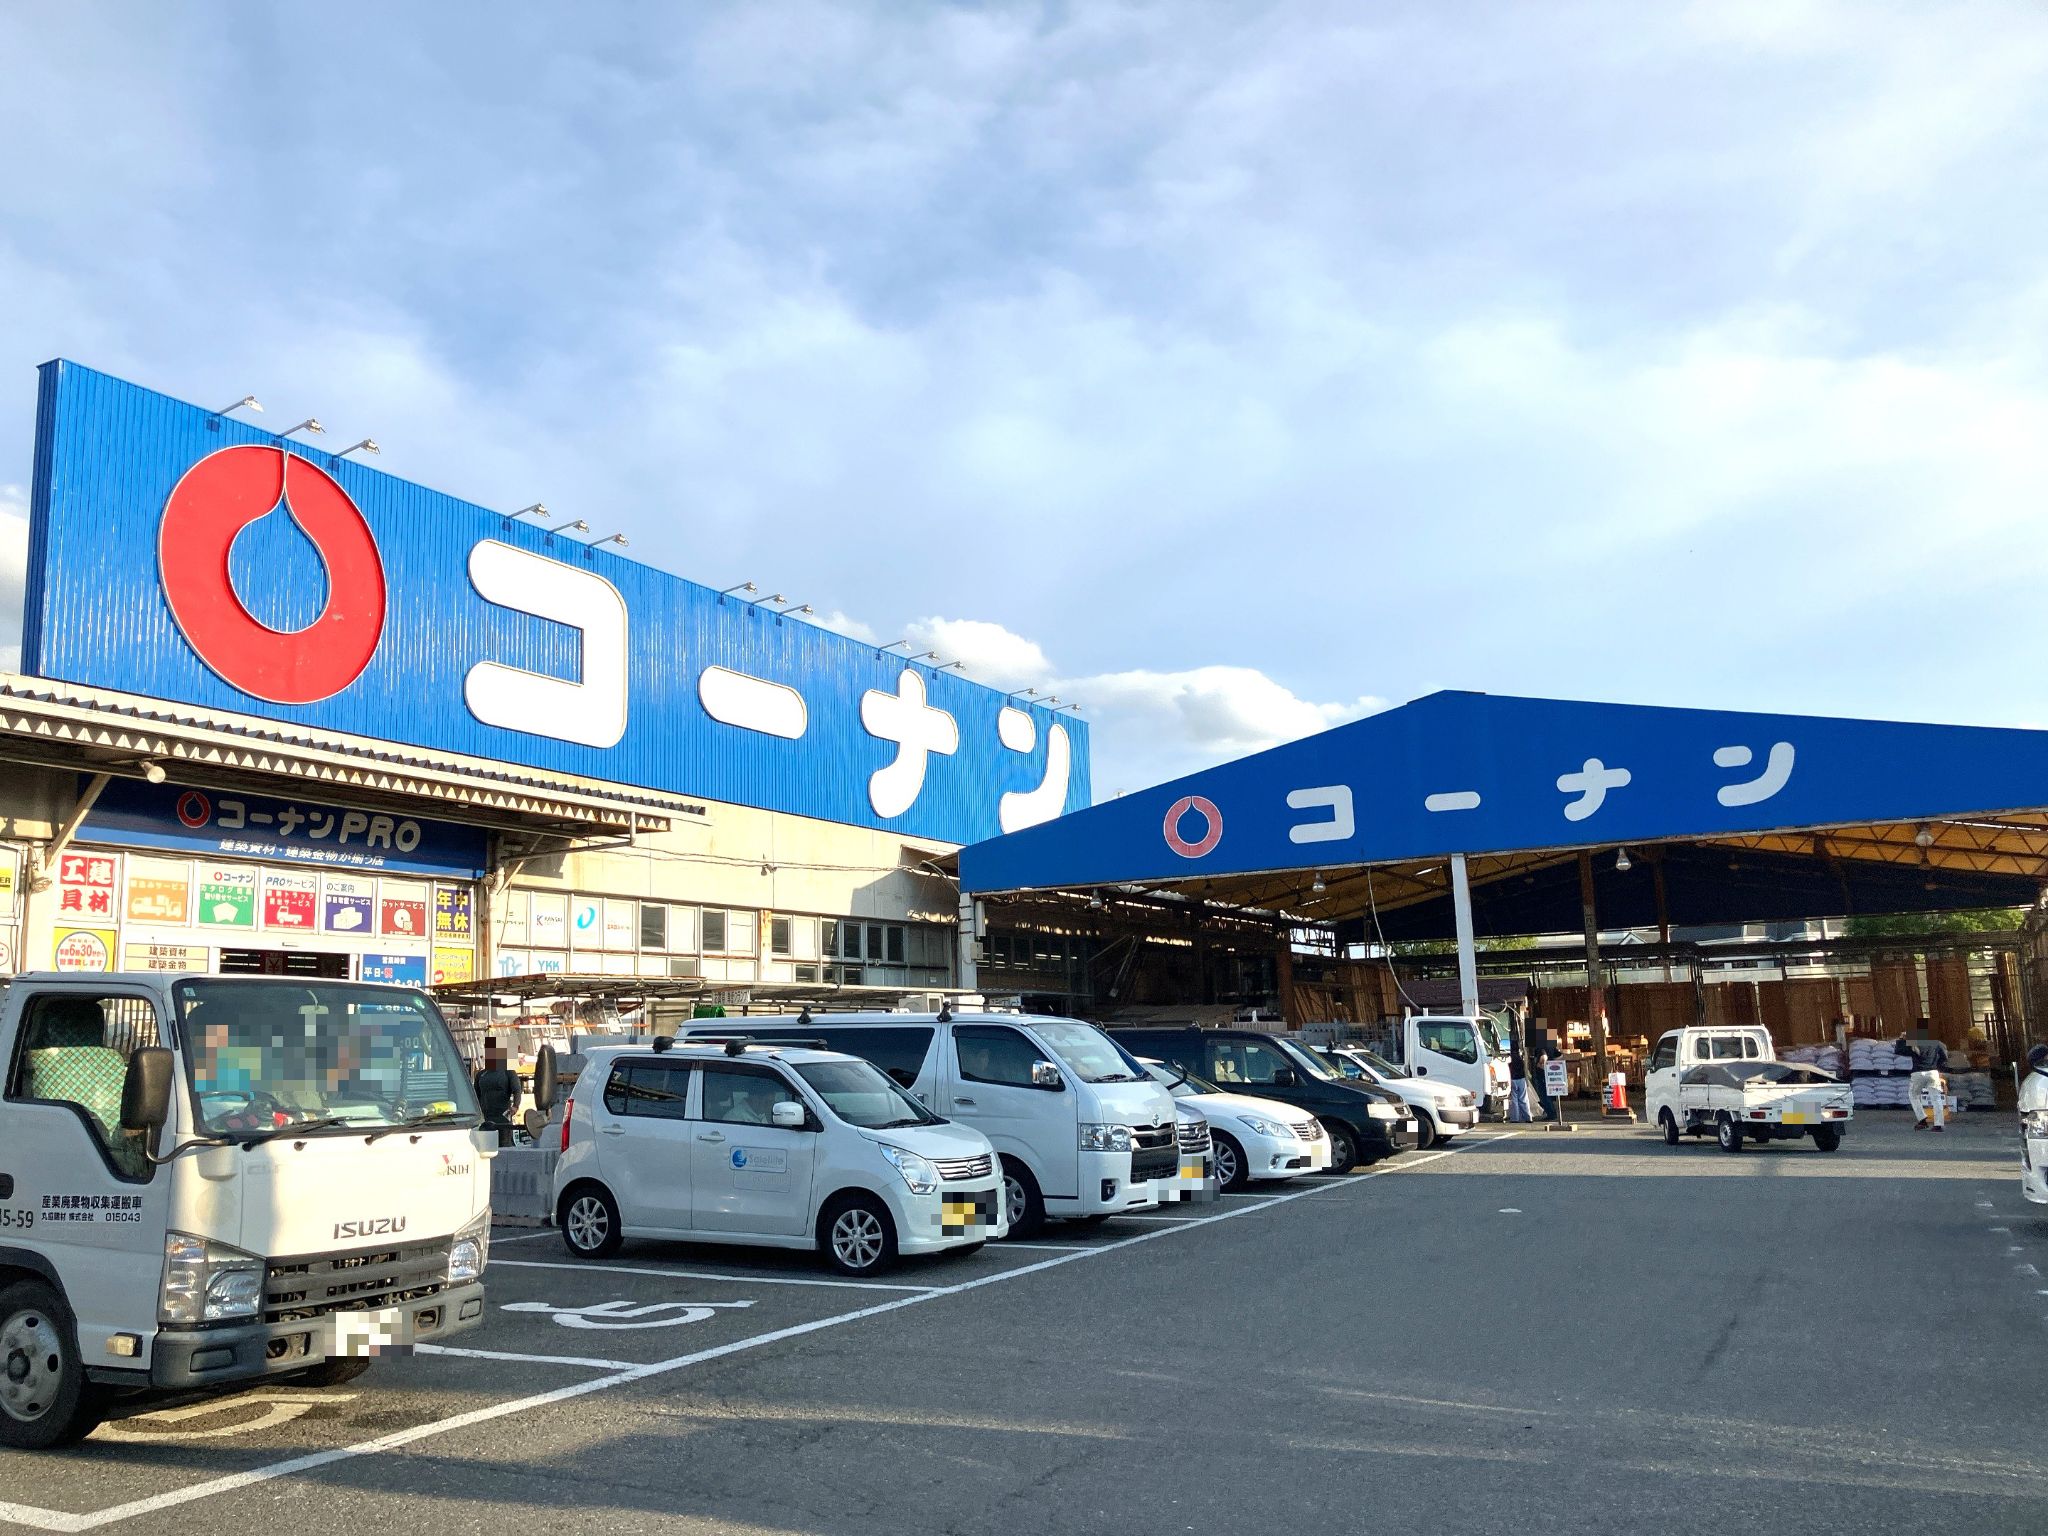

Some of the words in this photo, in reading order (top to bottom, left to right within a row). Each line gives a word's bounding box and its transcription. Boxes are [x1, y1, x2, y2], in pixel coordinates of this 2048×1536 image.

[464, 537, 1071, 834] コーナン
[1286, 741, 1796, 846] コーナン
[326, 883, 355, 894] のご案内
[436, 911, 469, 932] 無休
[148, 945, 187, 958] 建築資材
[148, 959, 187, 970] 建築金物
[41, 1195, 143, 1209] 産業廃棄物収集運搬車
[105, 1212, 141, 1222] 015043
[333, 1216, 406, 1239] ISUZU
